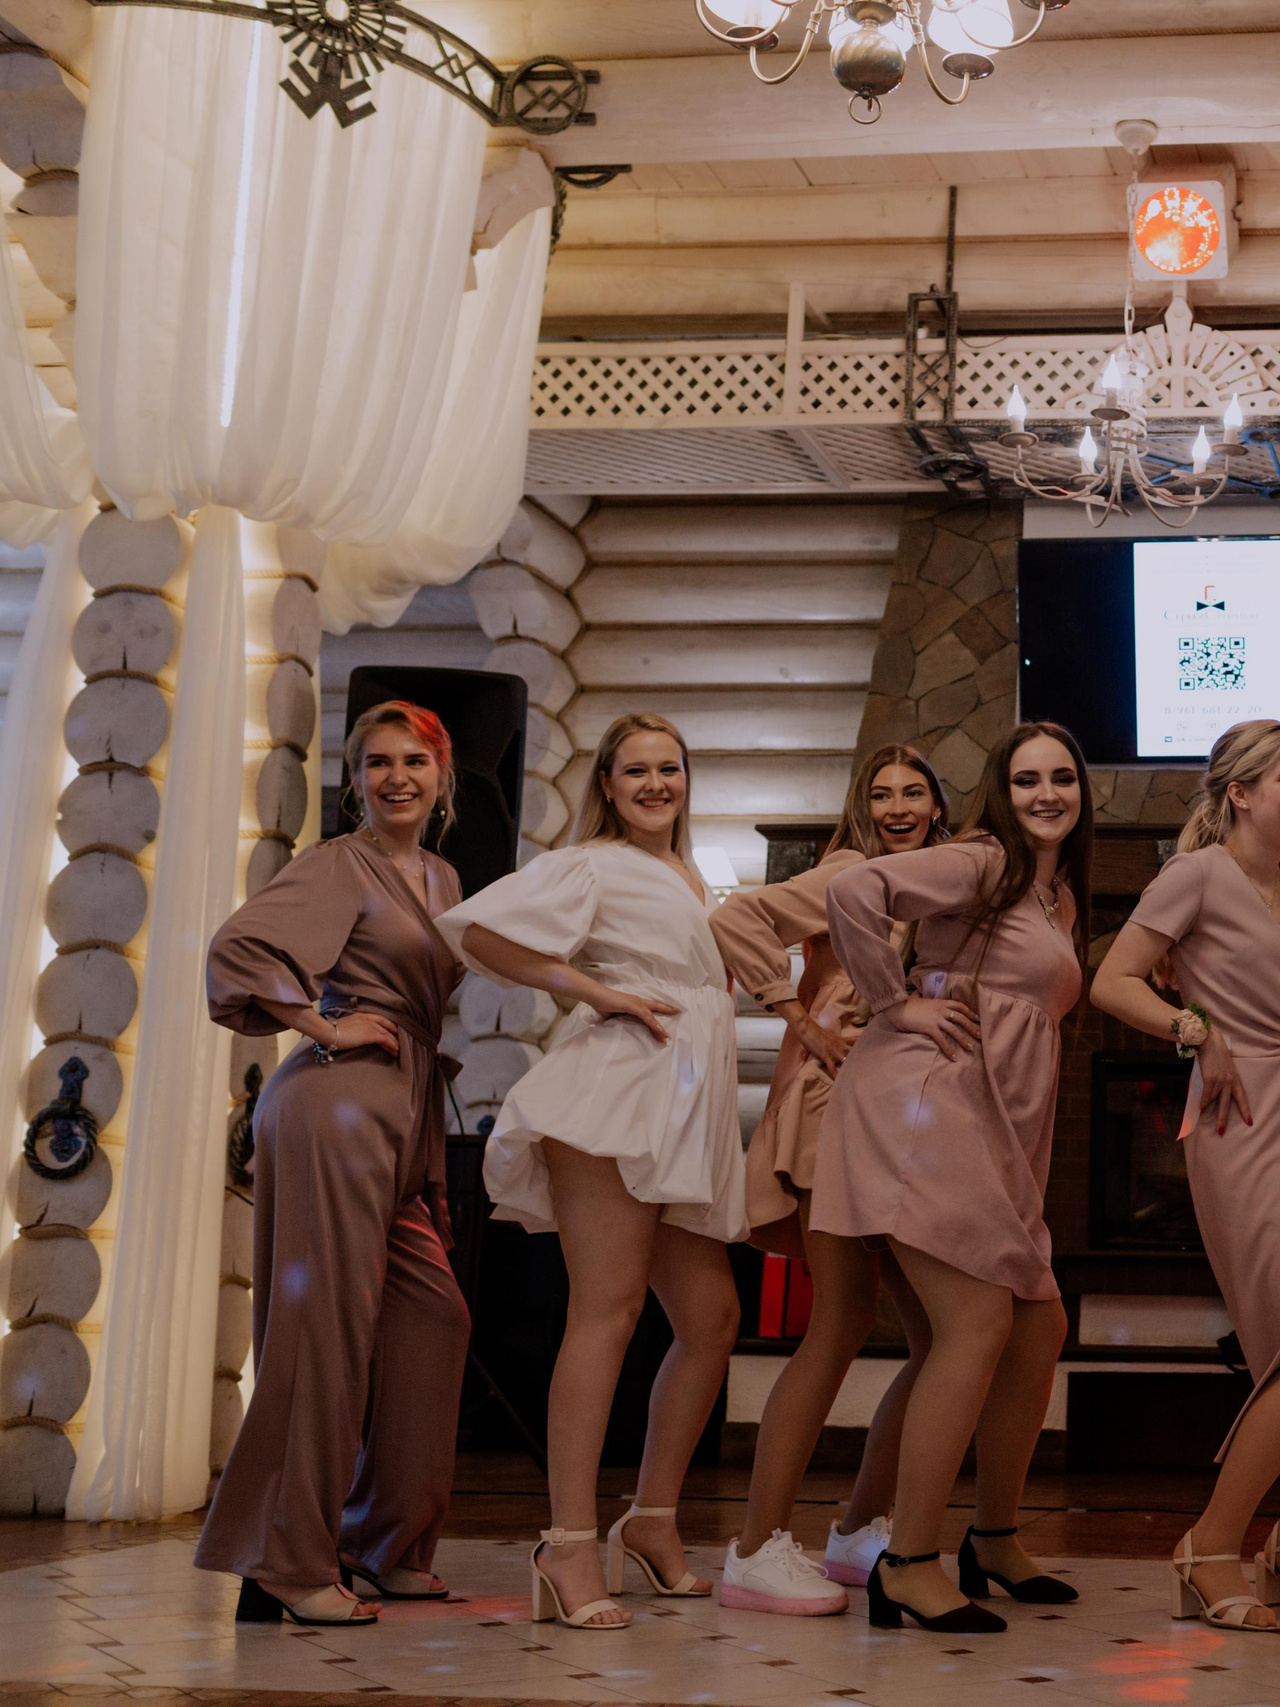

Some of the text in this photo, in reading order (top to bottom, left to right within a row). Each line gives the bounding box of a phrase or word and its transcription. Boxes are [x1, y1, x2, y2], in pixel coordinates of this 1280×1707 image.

[1164, 705, 1172, 714] 8
[1226, 705, 1240, 714] 22
[1247, 705, 1262, 714] 20
